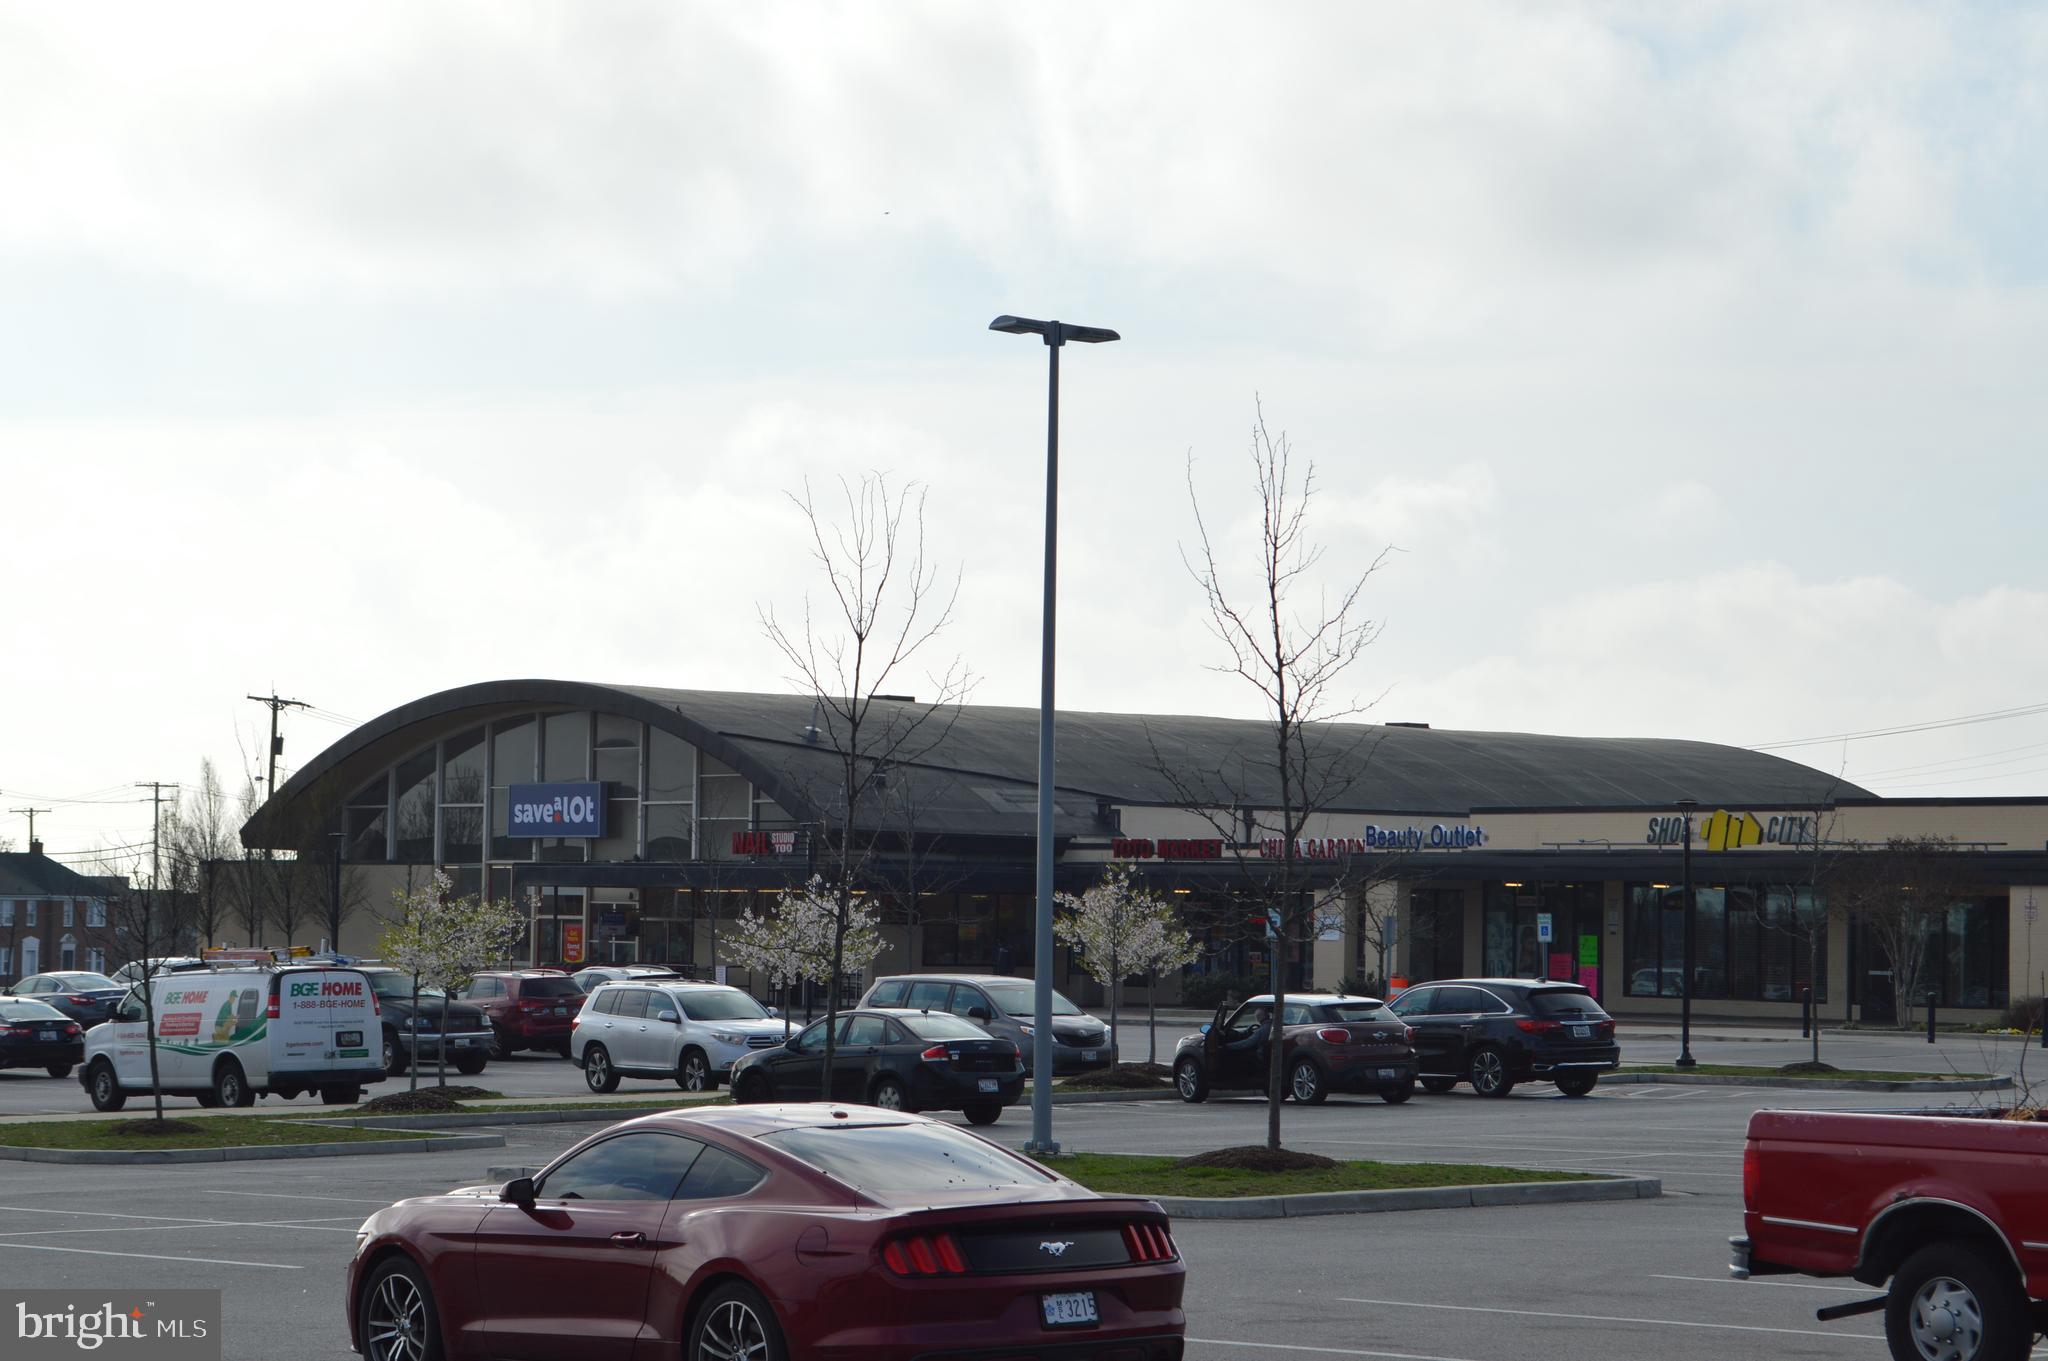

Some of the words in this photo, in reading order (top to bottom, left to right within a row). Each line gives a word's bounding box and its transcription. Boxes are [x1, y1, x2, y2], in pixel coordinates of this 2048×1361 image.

[513, 803, 553, 824] save
[771, 832, 795, 844] STUDIO
[1366, 825, 1423, 851] Beauty
[1431, 824, 1482, 848] Outlet
[1767, 816, 1810, 843] CITY
[775, 843, 793, 853] TOO
[1158, 839, 1222, 858] MARKET
[1260, 839, 1304, 858] CHIA
[1308, 838, 1366, 858] GARDEN
[165, 992, 183, 1005] BGE
[183, 990, 208, 1003] HOME
[290, 983, 319, 997] BGE
[321, 982, 362, 996] HOME
[293, 1000, 365, 1009] 1-888-BGE-HOME
[1066, 1297, 1096, 1318] 3215
